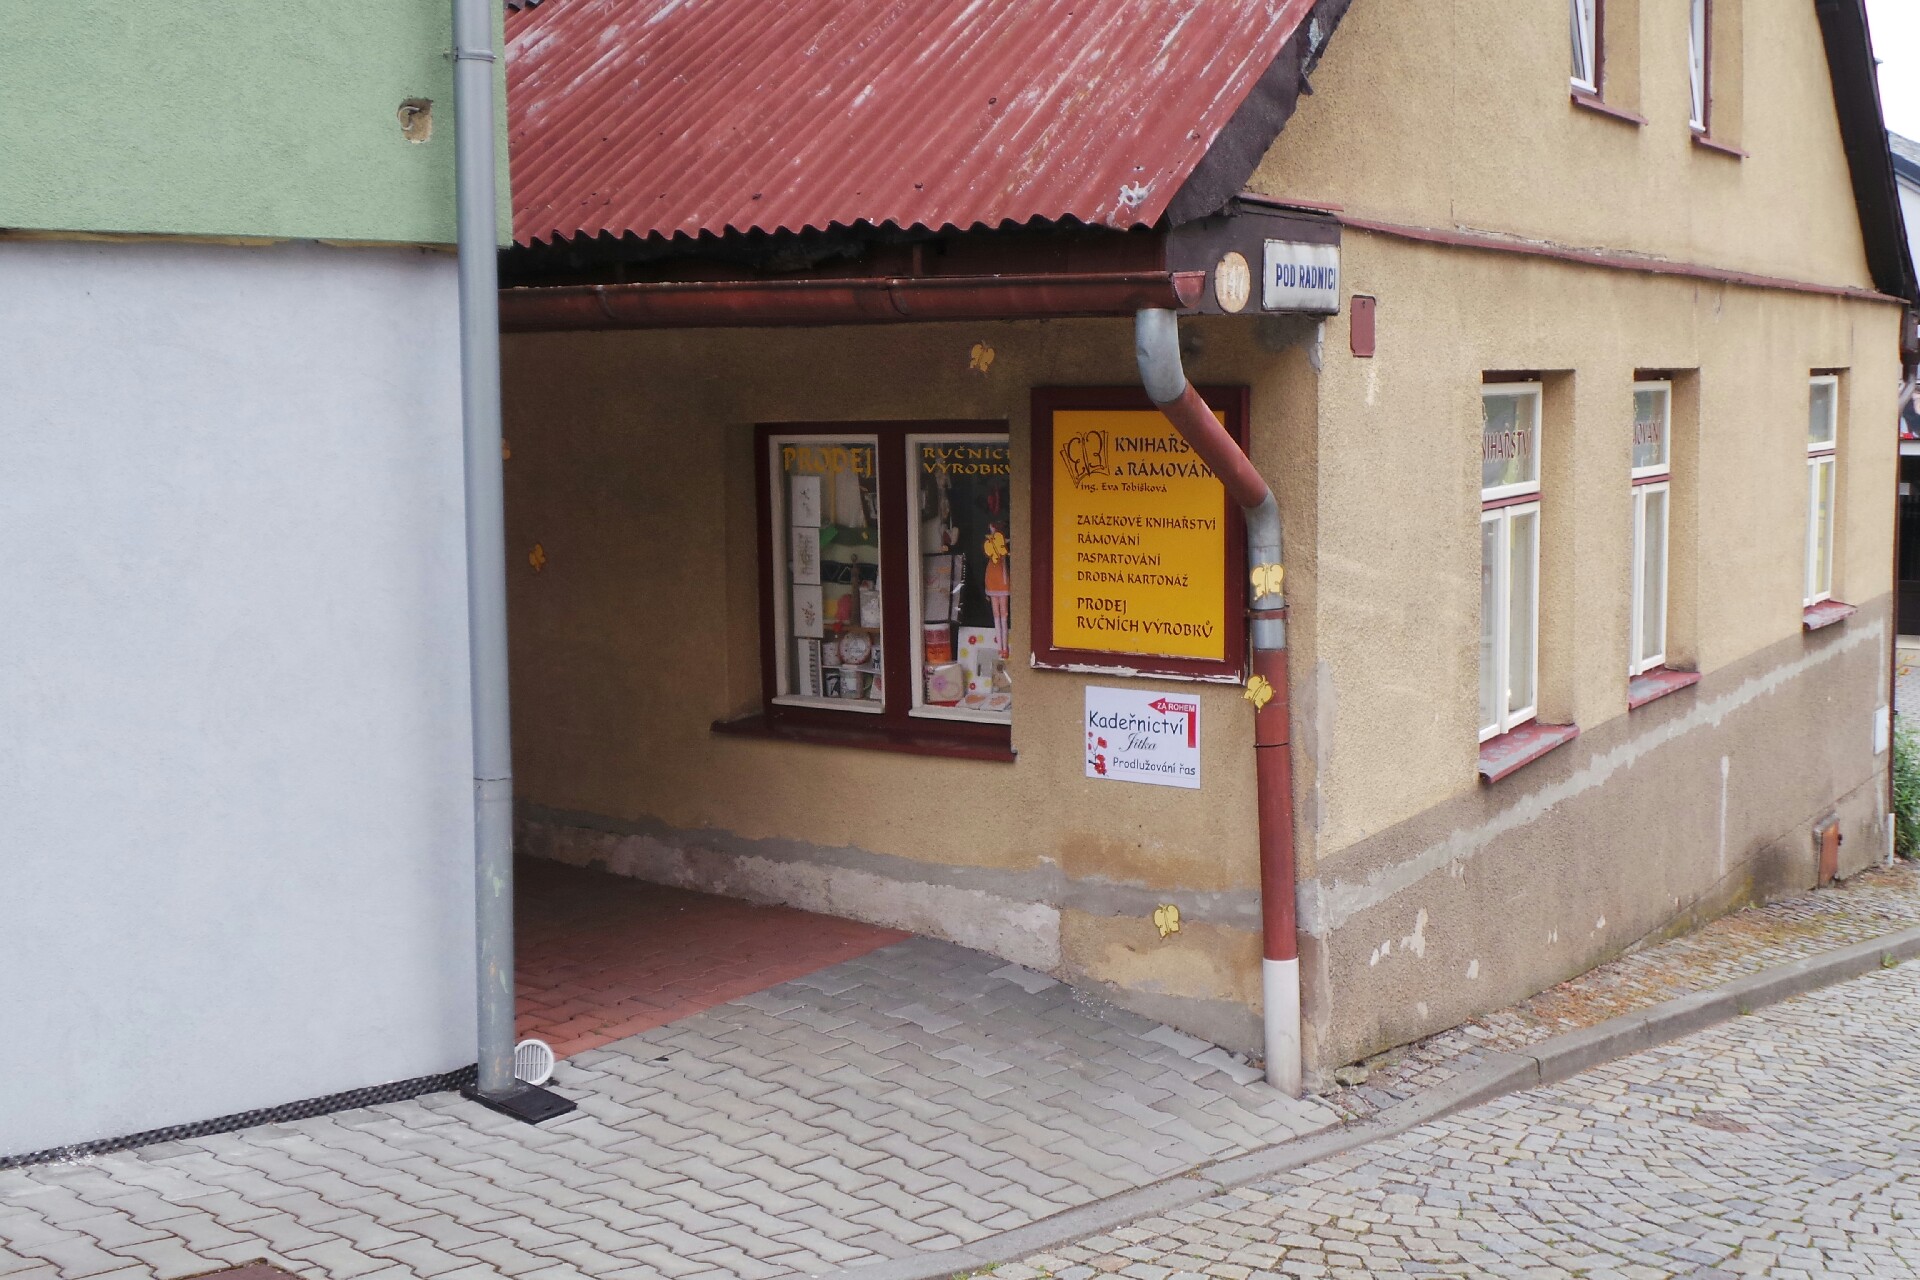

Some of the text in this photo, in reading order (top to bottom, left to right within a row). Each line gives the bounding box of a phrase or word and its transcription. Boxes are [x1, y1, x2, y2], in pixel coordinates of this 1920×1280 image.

[1275, 262, 1296, 288] POD
[1298, 264, 1336, 290] RADNICI
[1114, 433, 1197, 454] KNIHAŘS
[783, 447, 872, 479] PRODEJ
[1114, 459, 1217, 479] a RÁMOVÁN
[1081, 482, 1168, 494] ing. Eva Tobišková
[1077, 513, 1216, 531] ZAKÁZKOVÉ KNIHAŘSTVÍ
[1077, 531, 1140, 546] RÁMOVÁNÍ
[1077, 552, 1161, 567] PASPARTOVÁNÍ
[1077, 570, 1189, 587] DROBNÁ KARTONÁŽ
[1077, 597, 1127, 615] PRODEJ
[1077, 614, 1214, 638] RUČNÍCH VÝROBKŮ
[1157, 702, 1196, 713] ZA ROHEM
[1089, 710, 1184, 735] Kadeřnictví
[1118, 732, 1158, 753] Jitka
[1113, 756, 1196, 776] Prodlužování řas
